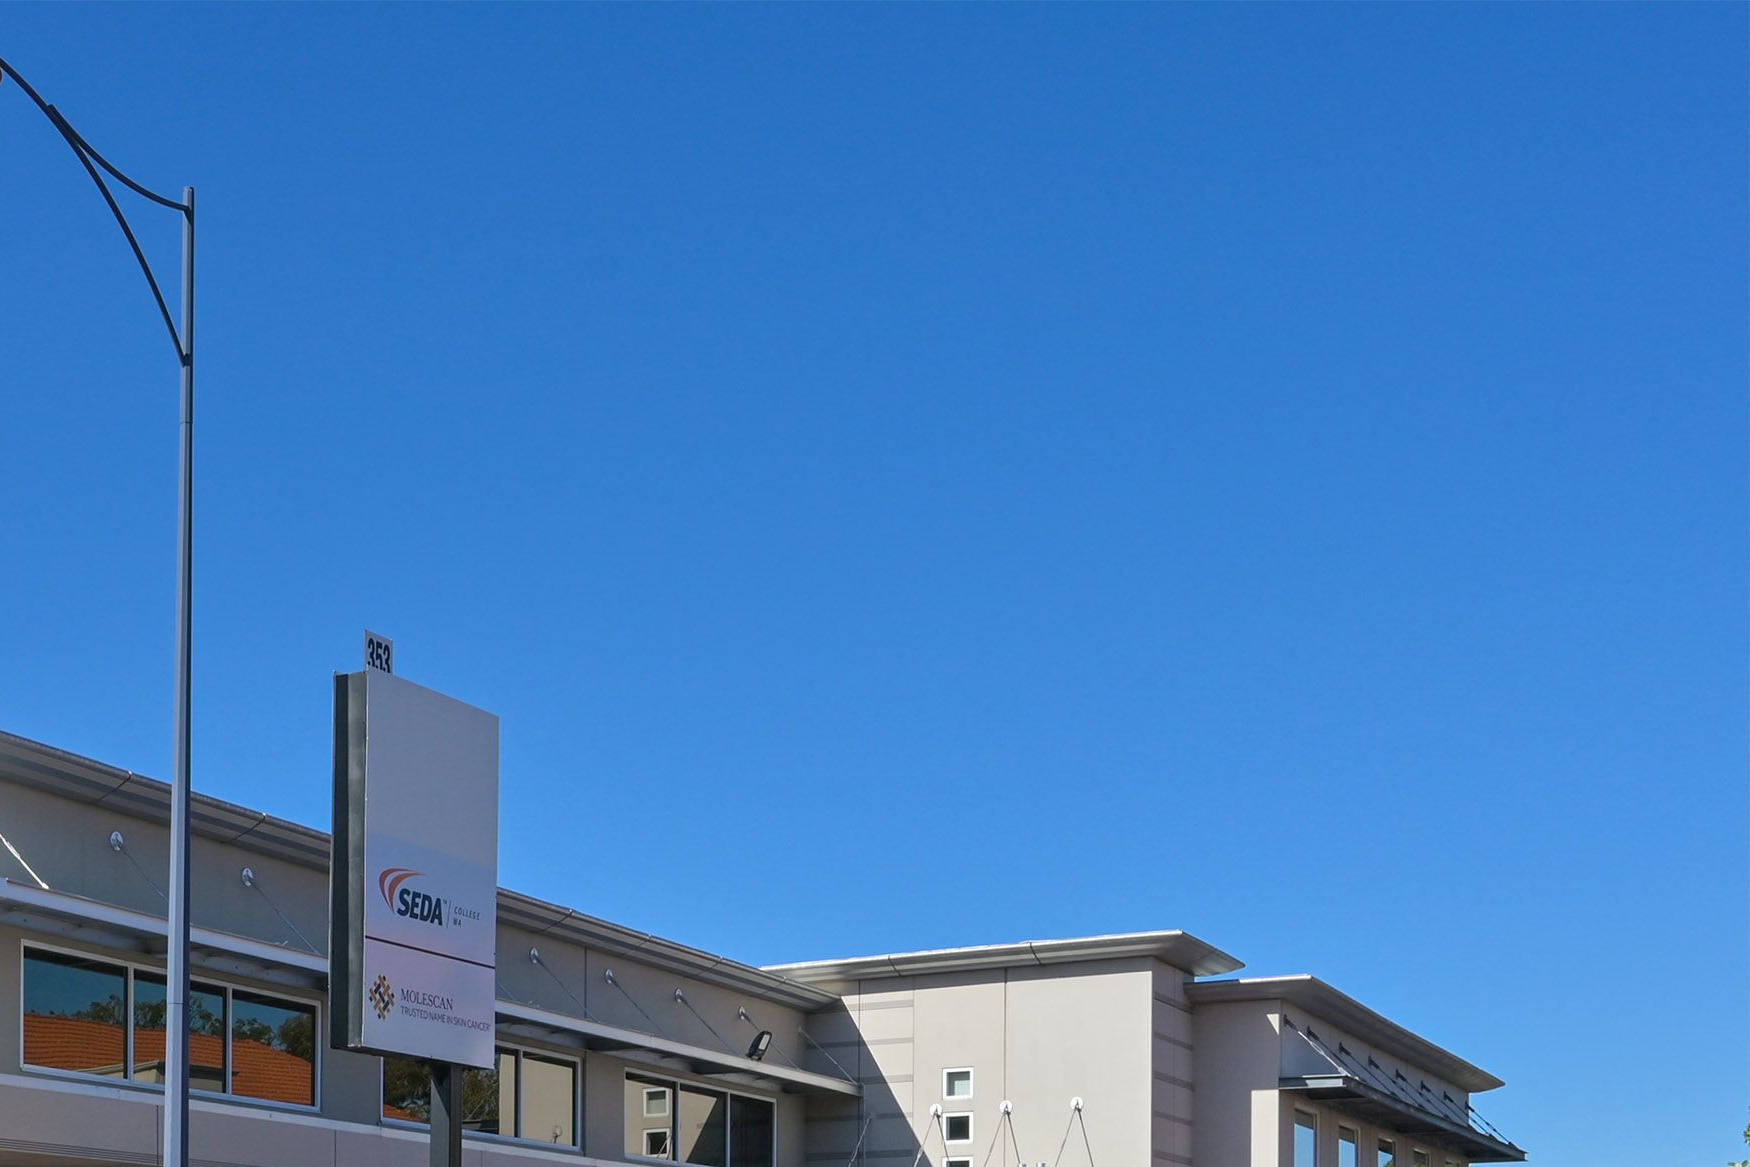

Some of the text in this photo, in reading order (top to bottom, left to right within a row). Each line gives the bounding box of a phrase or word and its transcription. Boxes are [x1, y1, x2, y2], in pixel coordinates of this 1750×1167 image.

[367, 637, 391, 674] 353
[397, 888, 443, 926] SEDA
[454, 905, 481, 920] COLLEGE
[400, 988, 453, 1011] MOLESCAN
[400, 1005, 429, 1020] TRUSTED
[429, 1012, 447, 1024] NAME
[454, 1017, 467, 1027] SKIN
[468, 1020, 490, 1032] CANCER
